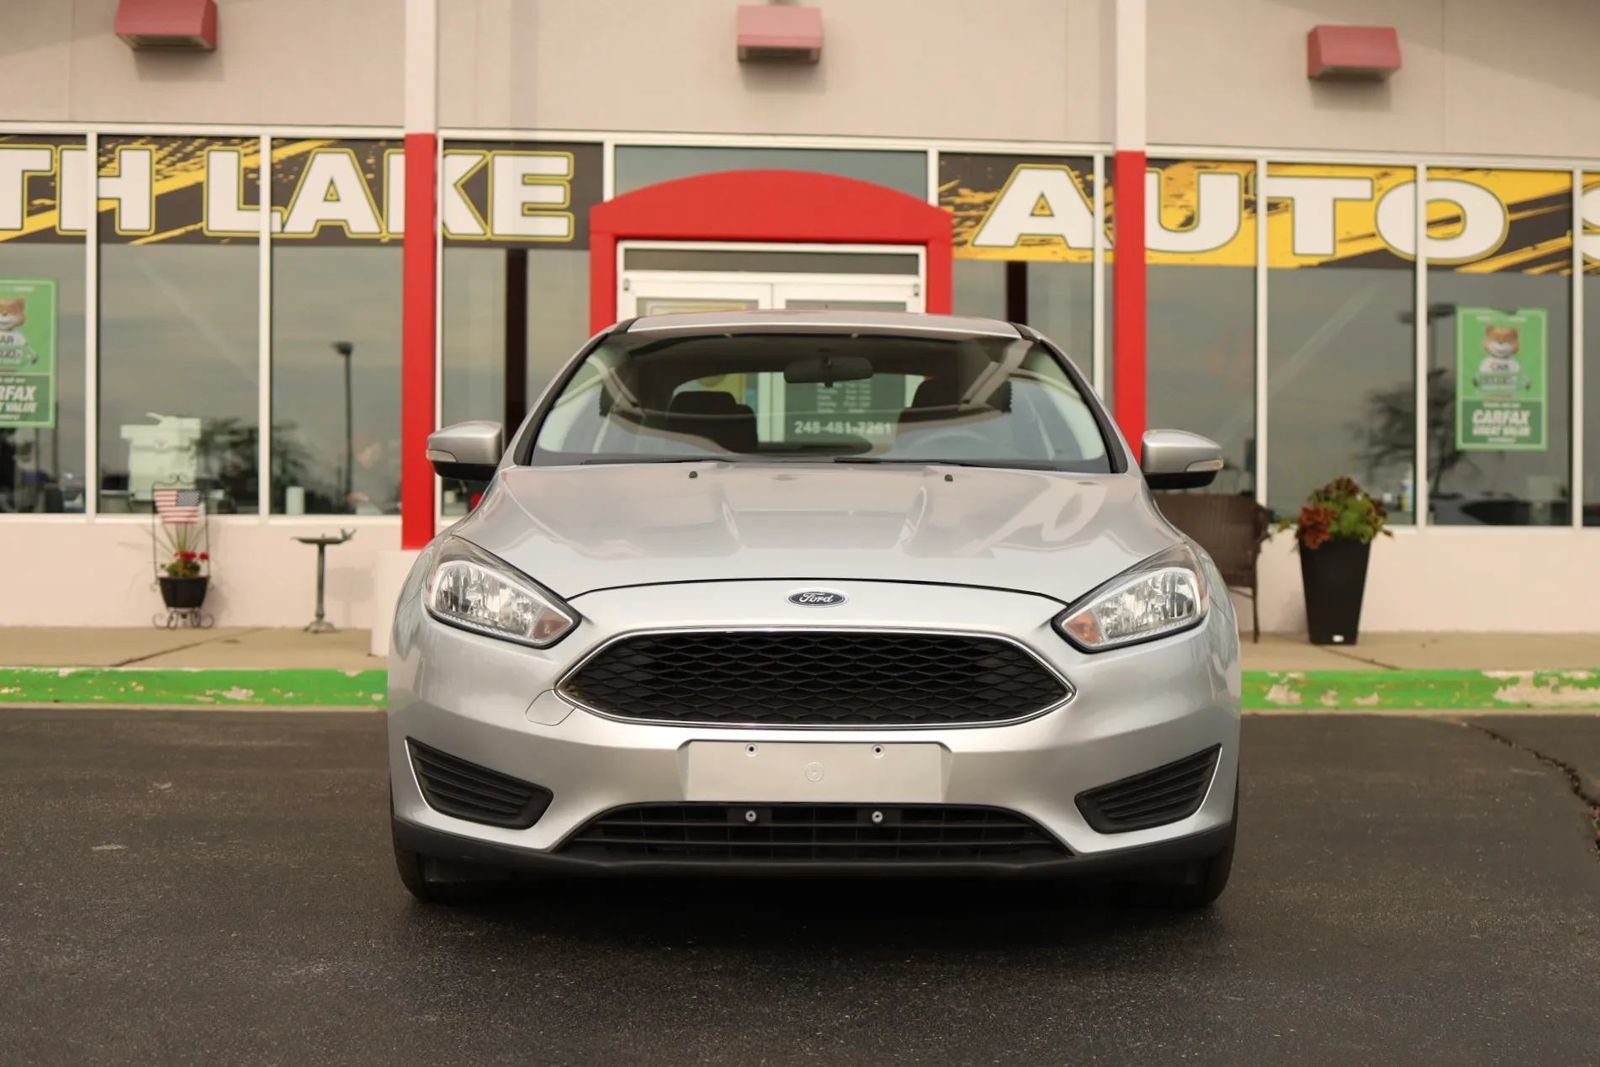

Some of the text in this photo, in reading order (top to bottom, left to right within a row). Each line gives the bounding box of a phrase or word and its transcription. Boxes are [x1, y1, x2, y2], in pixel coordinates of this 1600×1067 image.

[204, 147, 574, 241] LAKE
[972, 164, 1510, 262] AUTO
[1473, 409, 1530, 425] CARFAX
[798, 591, 834, 603] Ford
